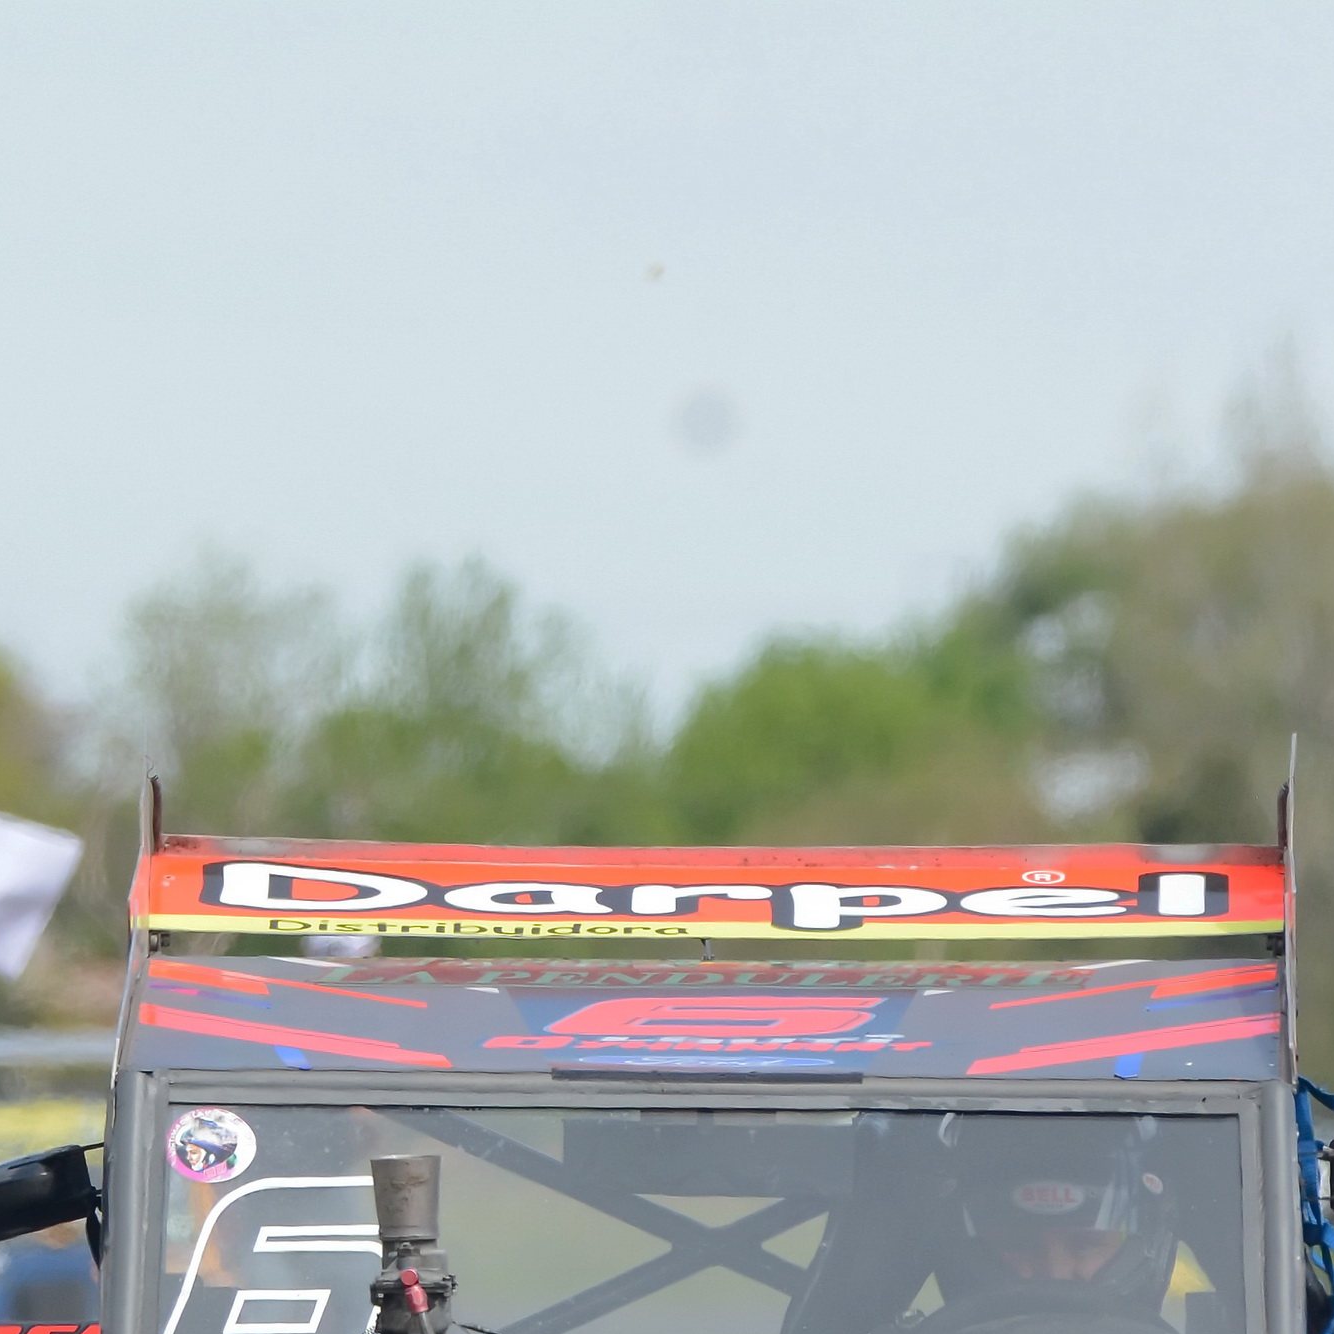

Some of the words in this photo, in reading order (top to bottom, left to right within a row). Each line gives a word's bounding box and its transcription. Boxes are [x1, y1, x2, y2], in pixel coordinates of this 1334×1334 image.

[201, 860, 1229, 932] Darpel
[268, 918, 689, 938] Distribuidora
[545, 996, 888, 1037] 6
[1022, 1186, 1079, 1204] BELL
